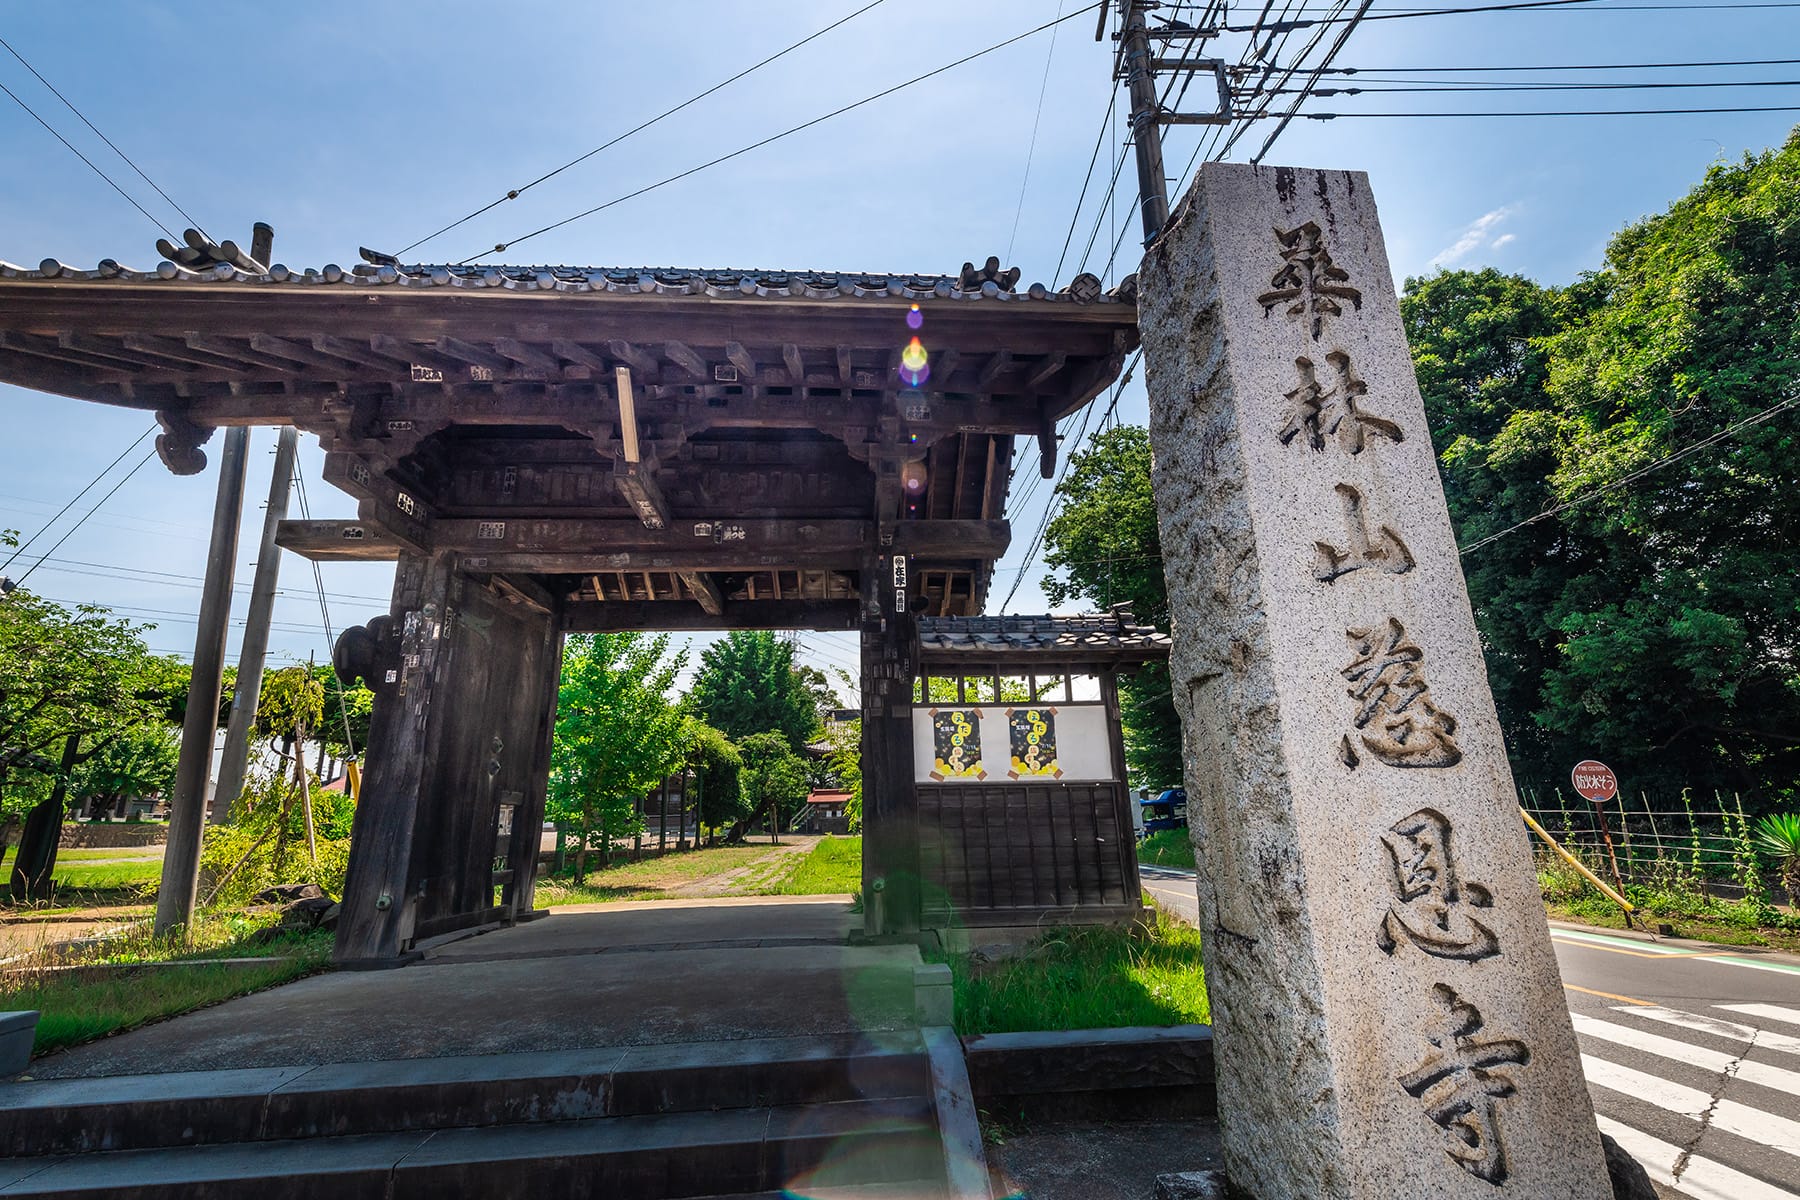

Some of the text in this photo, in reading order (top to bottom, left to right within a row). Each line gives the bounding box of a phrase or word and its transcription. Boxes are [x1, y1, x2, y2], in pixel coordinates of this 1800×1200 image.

[1575, 774, 1615, 790] 防火水そう
